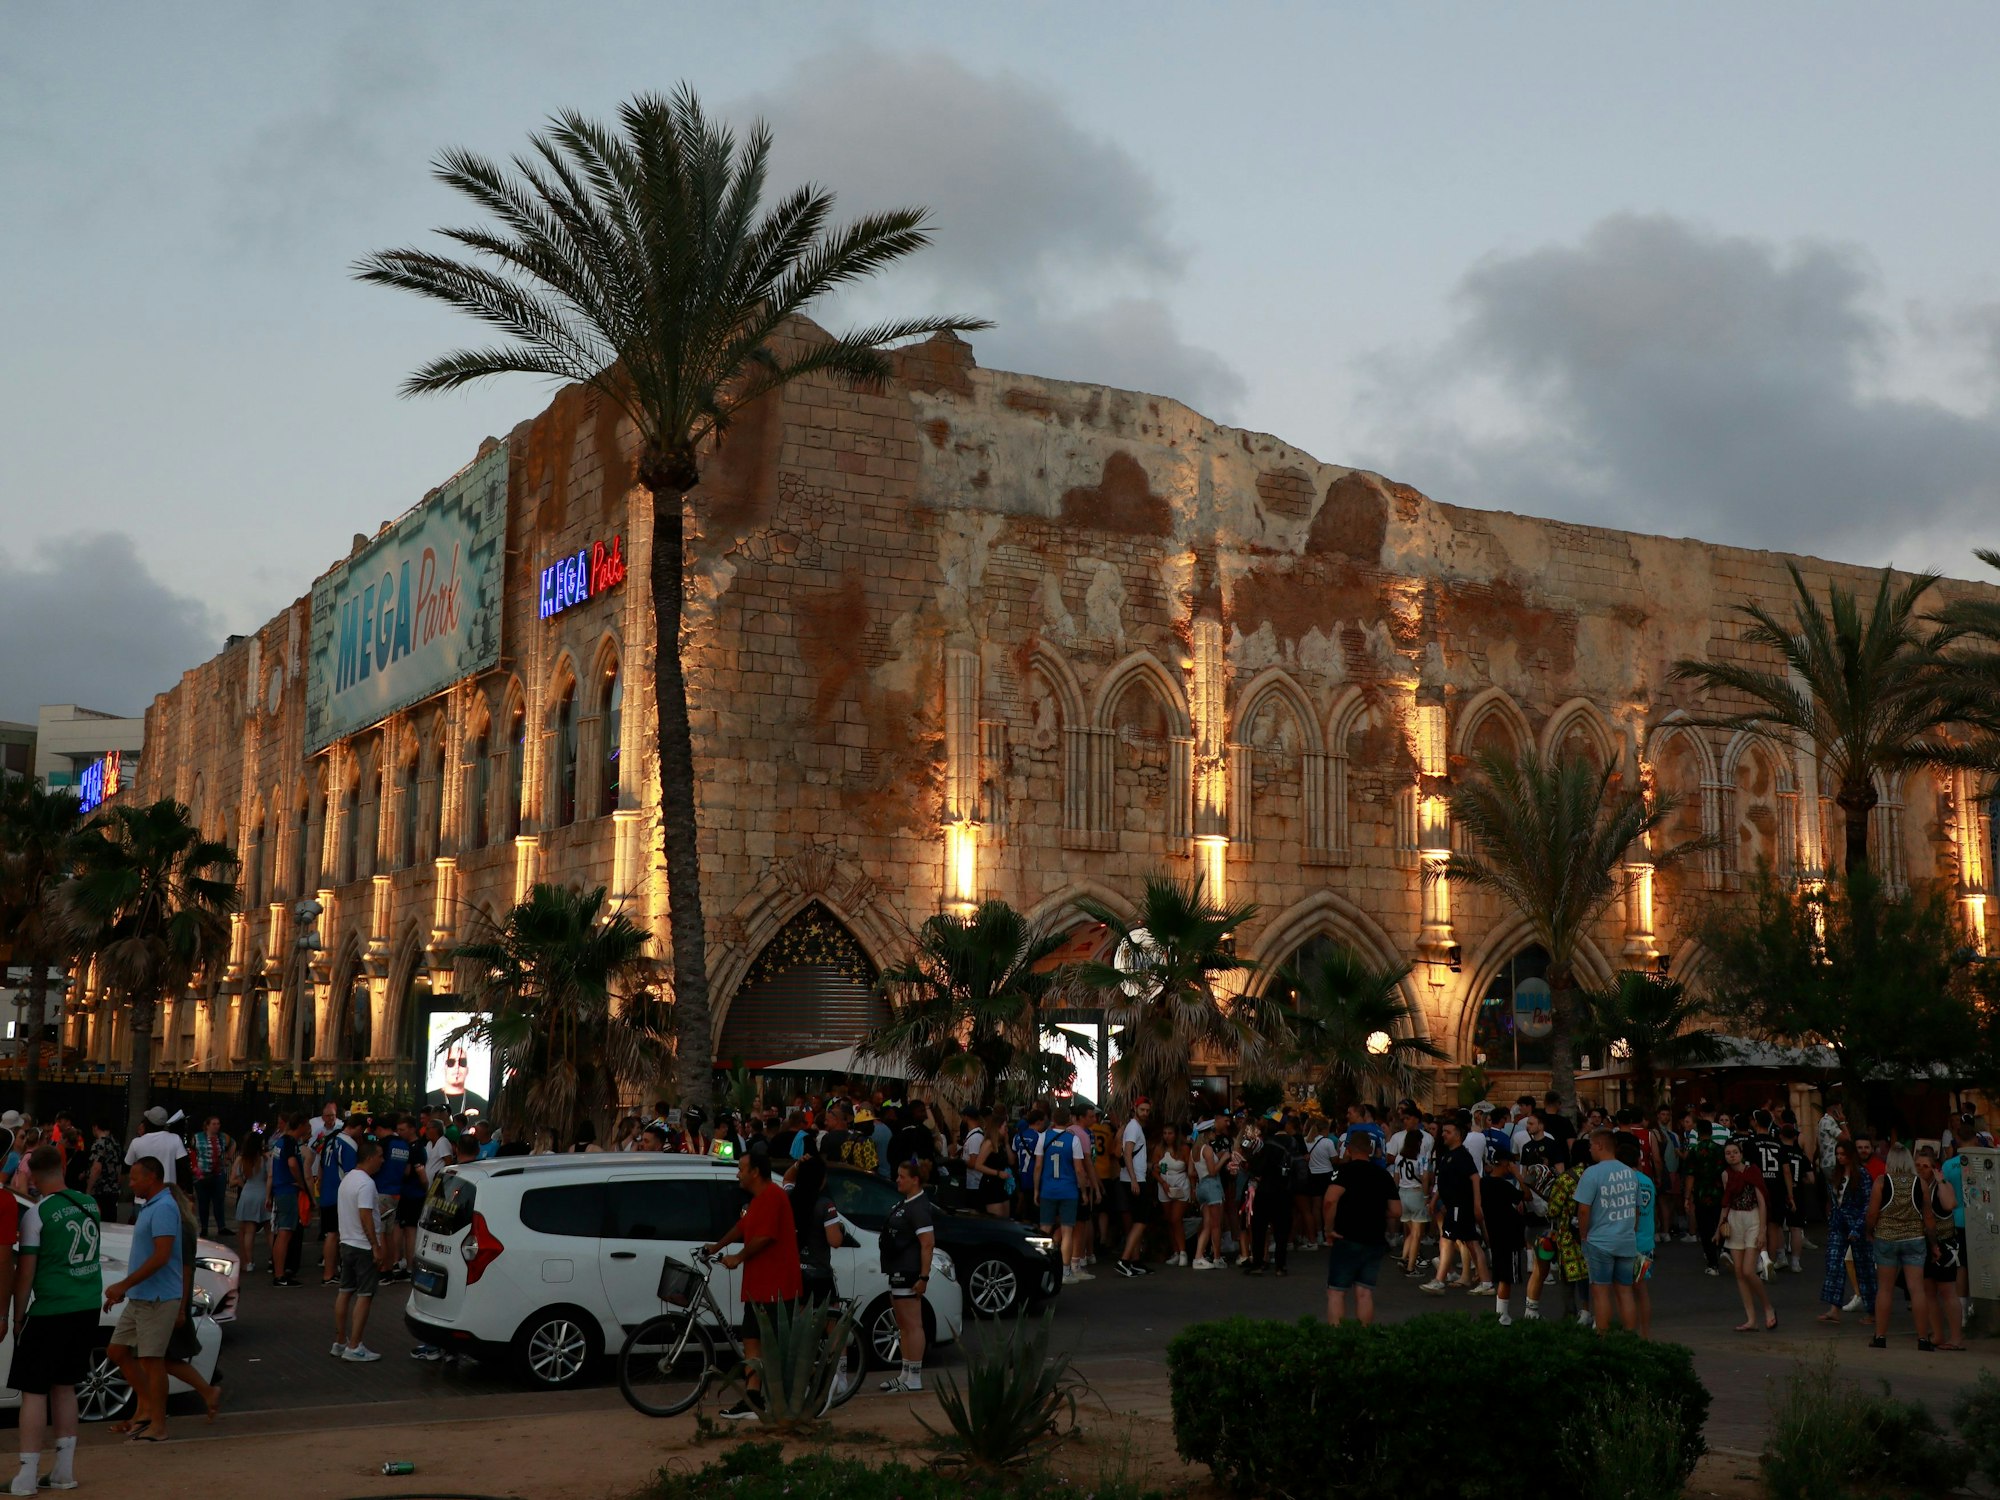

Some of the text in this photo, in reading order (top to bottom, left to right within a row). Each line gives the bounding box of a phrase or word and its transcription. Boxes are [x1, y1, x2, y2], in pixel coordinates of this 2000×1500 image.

[540, 535, 625, 620] MEGA Park
[335, 542, 461, 694] MEGA Park
[1050, 1153, 1060, 1179] 1
[1758, 1147, 1779, 1172] 15
[1608, 1169, 1632, 1182] ANTI
[1600, 1193, 1636, 1209] RADLE
[51, 1209, 63, 1222] SV
[1608, 1208, 1636, 1221] CLUB
[65, 1216, 99, 1265] 29
